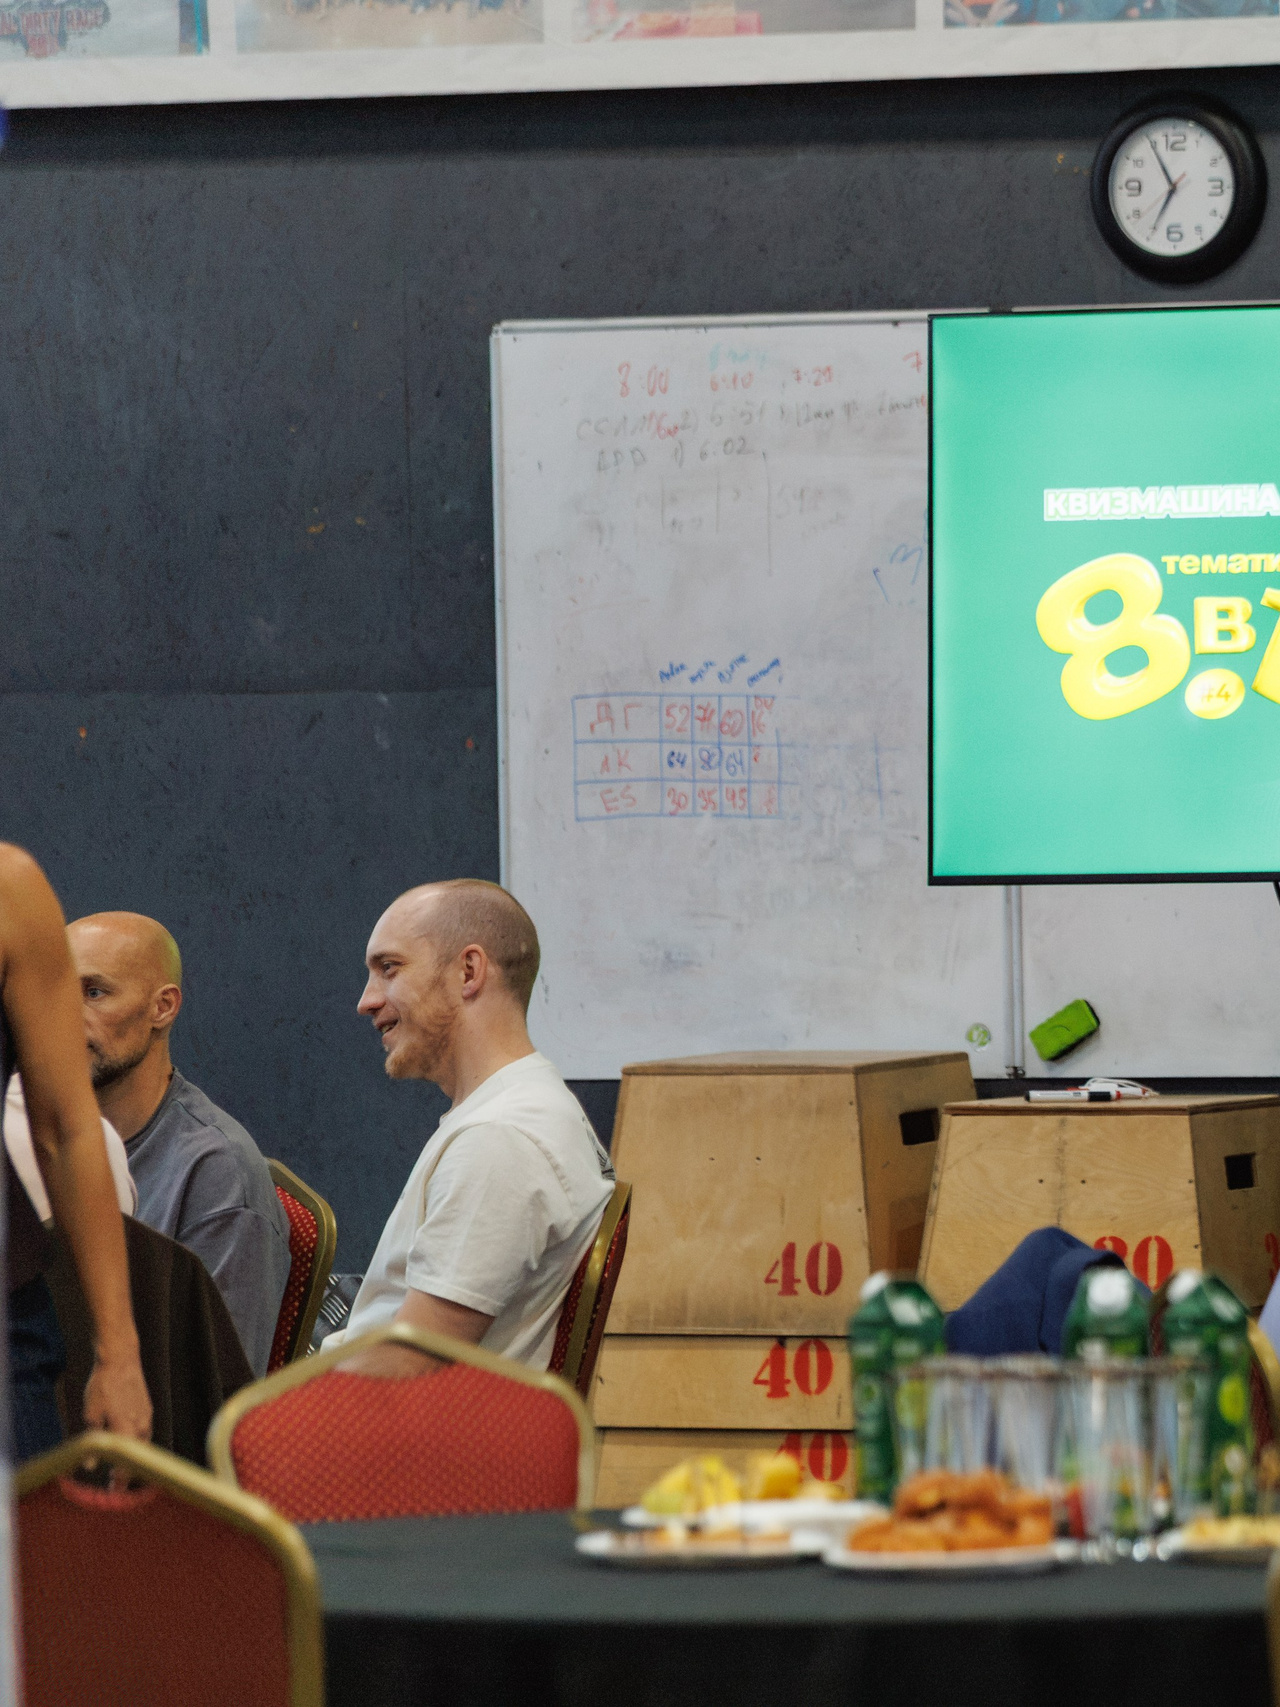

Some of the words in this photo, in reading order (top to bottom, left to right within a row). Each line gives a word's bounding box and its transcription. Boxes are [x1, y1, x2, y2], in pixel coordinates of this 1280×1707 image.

[1162, 132, 1187, 152] 12
[1125, 179, 1141, 197] 9
[1208, 177, 1225, 197] 3
[1166, 223, 1183, 242] 6
[1036, 553, 1191, 721] 8
[764, 1241, 843, 1296] 40
[752, 1337, 834, 1398] 40
